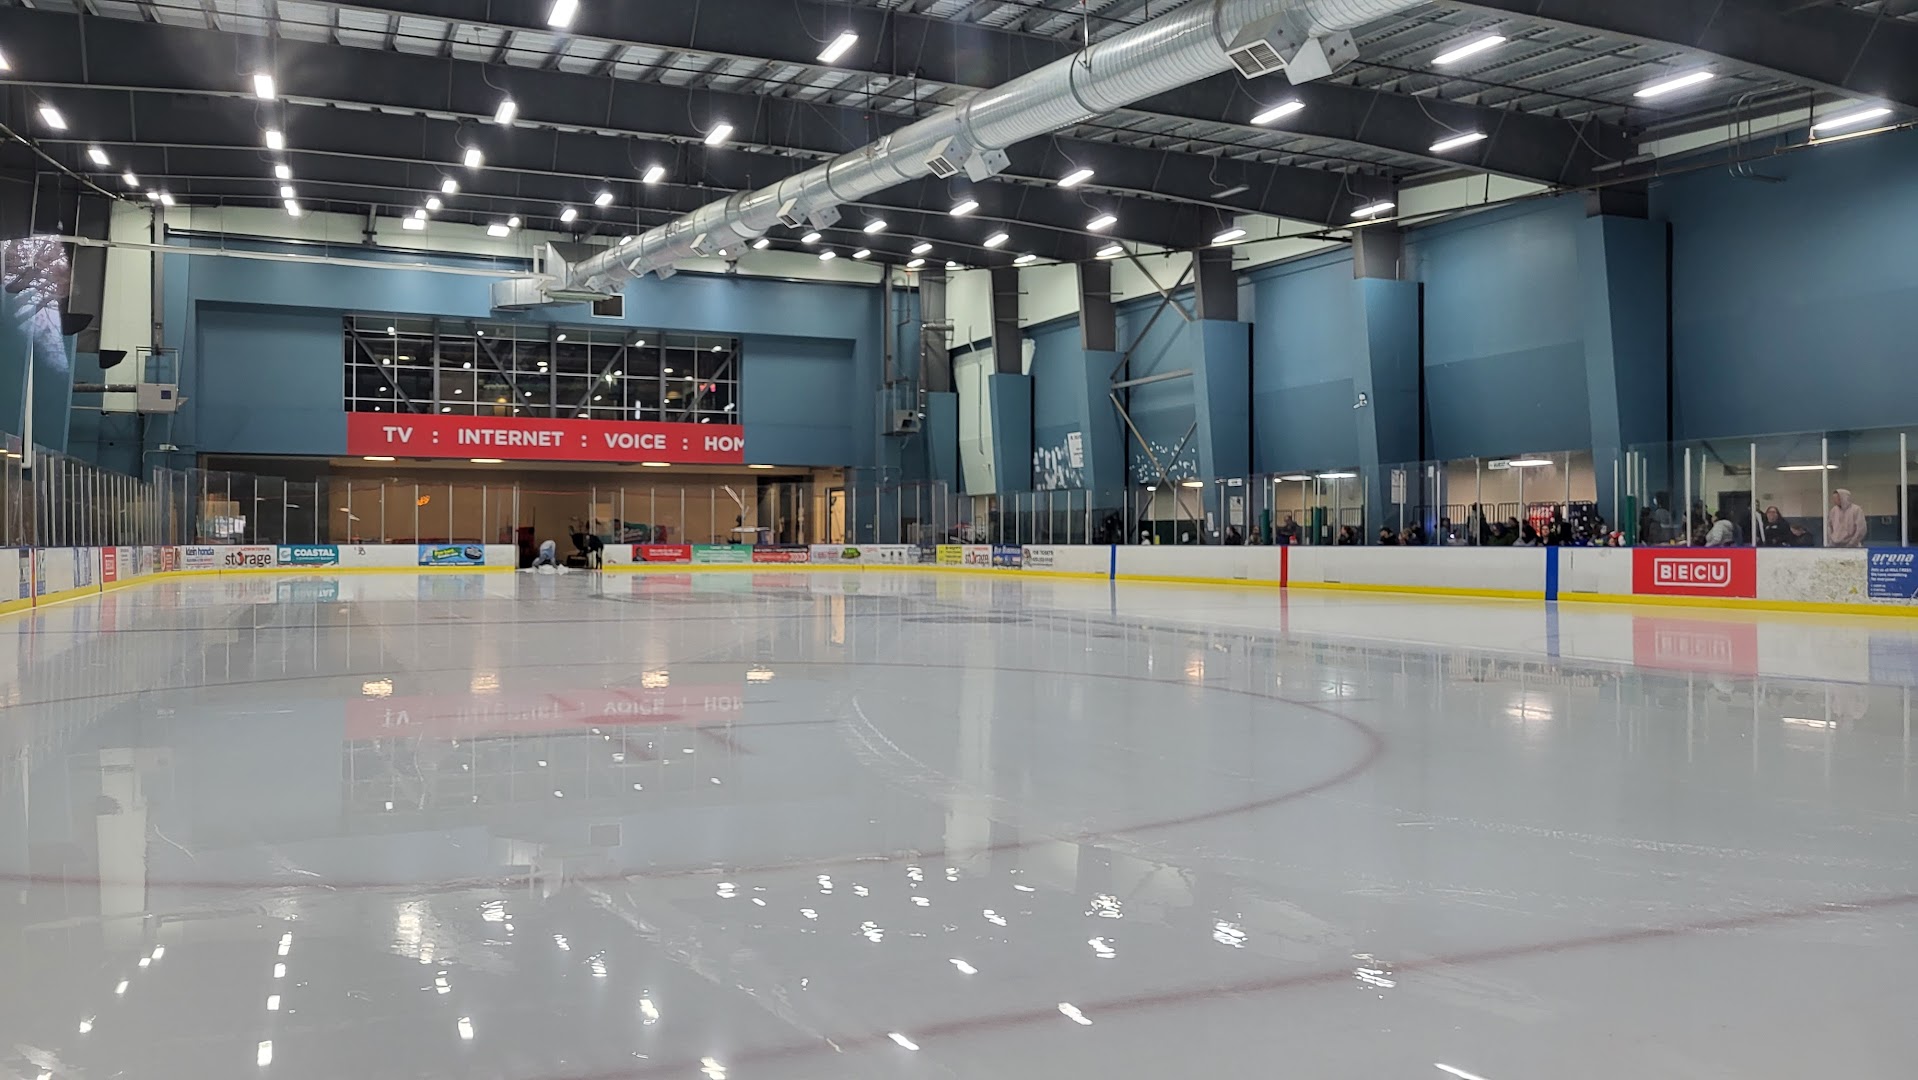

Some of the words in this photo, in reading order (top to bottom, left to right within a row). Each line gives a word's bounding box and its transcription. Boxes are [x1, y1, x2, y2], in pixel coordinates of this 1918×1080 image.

[382, 426, 413, 443] TV
[458, 428, 564, 447] INTERNET
[604, 433, 667, 449] VOICE
[704, 435, 745, 452] HOM
[198, 547, 214, 555] honda
[294, 549, 335, 557] COASTAL
[225, 552, 271, 567] storage
[1871, 553, 1915, 563] arena
[1660, 564, 1725, 581] BECU
